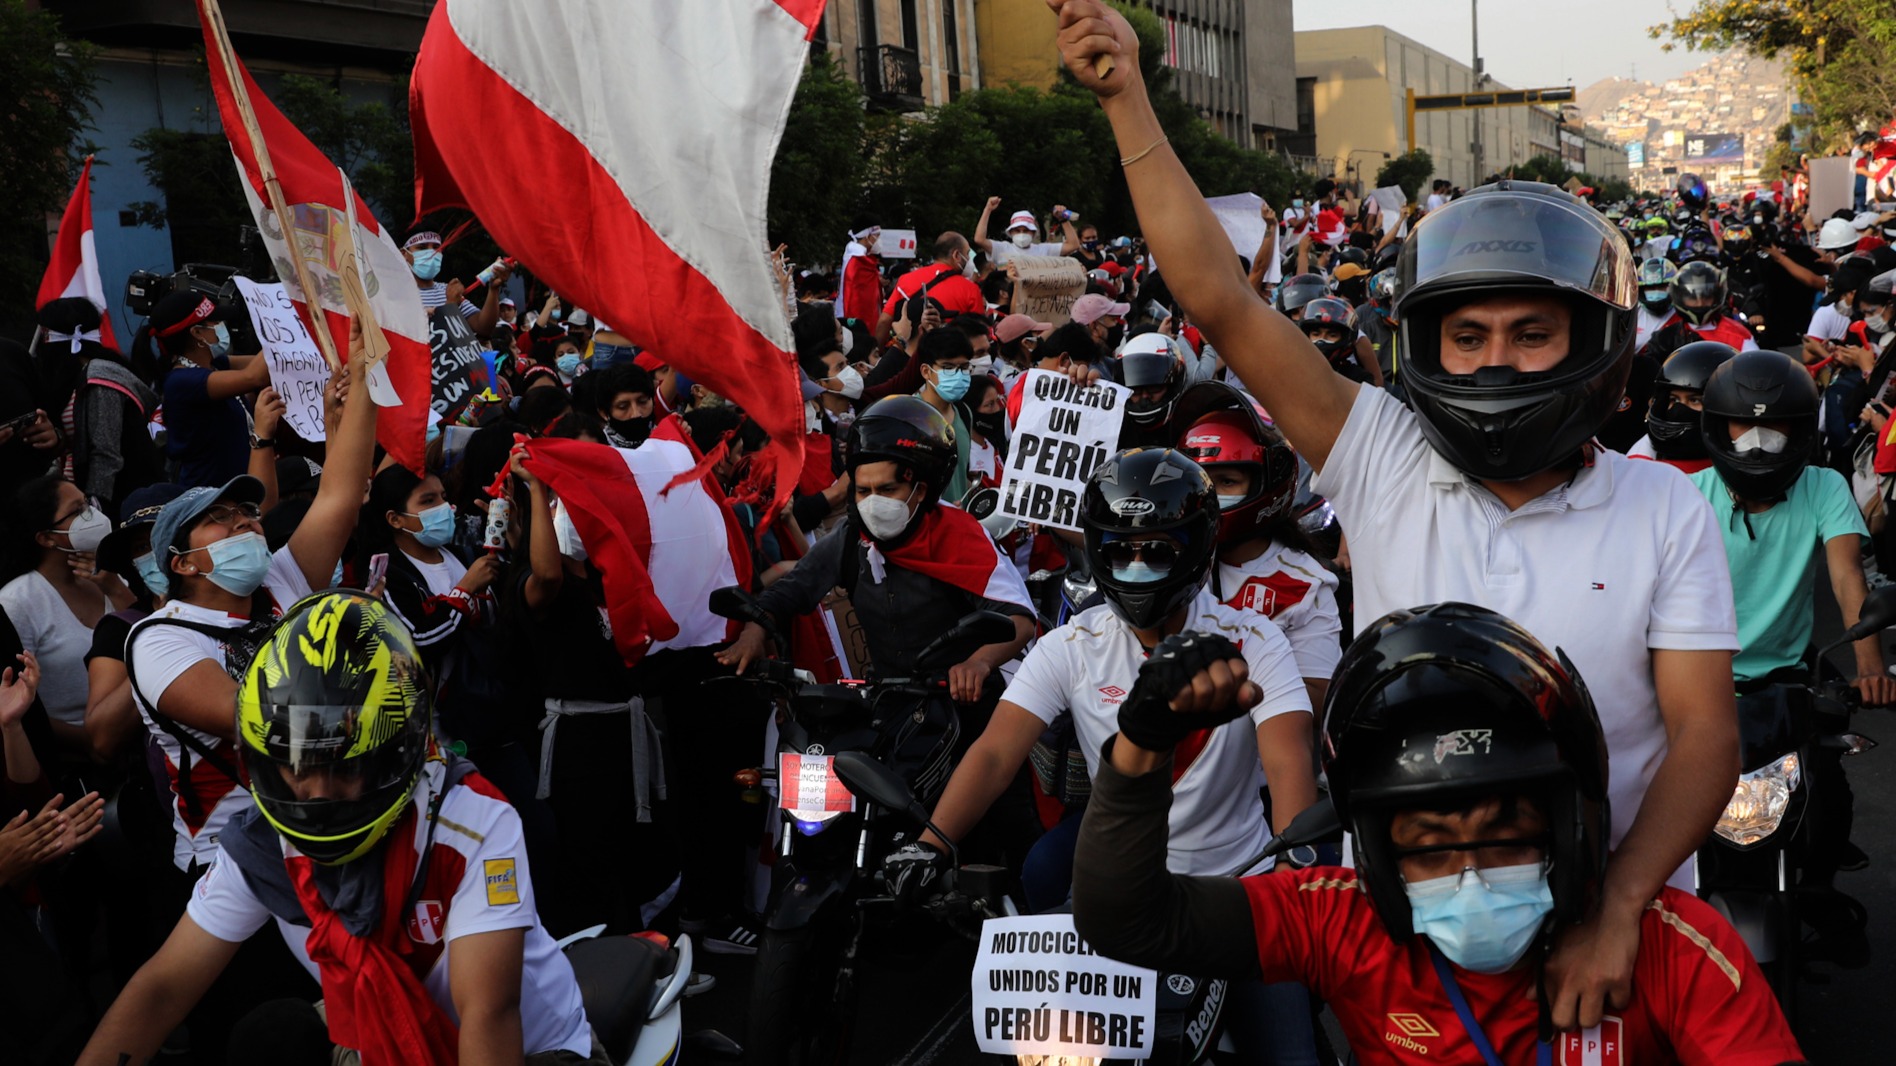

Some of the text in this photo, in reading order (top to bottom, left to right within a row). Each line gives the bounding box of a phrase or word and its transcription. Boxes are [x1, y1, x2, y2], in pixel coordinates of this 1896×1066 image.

[444, 315, 470, 339] UN
[1034, 374, 1118, 411] QUIERO
[1048, 407, 1082, 436] UN
[1013, 432, 1107, 484] PERÚ
[800, 762, 831, 771] MOTERO
[487, 874, 509, 884] FIFA
[991, 931, 1101, 957] MOTOCICL
[989, 969, 1142, 999] UNIDOS POR UN
[985, 1002, 1145, 1049] PERÚ LIBRE
[1385, 1031, 1428, 1055] umbro
[1571, 1038, 1615, 1056] FPF
